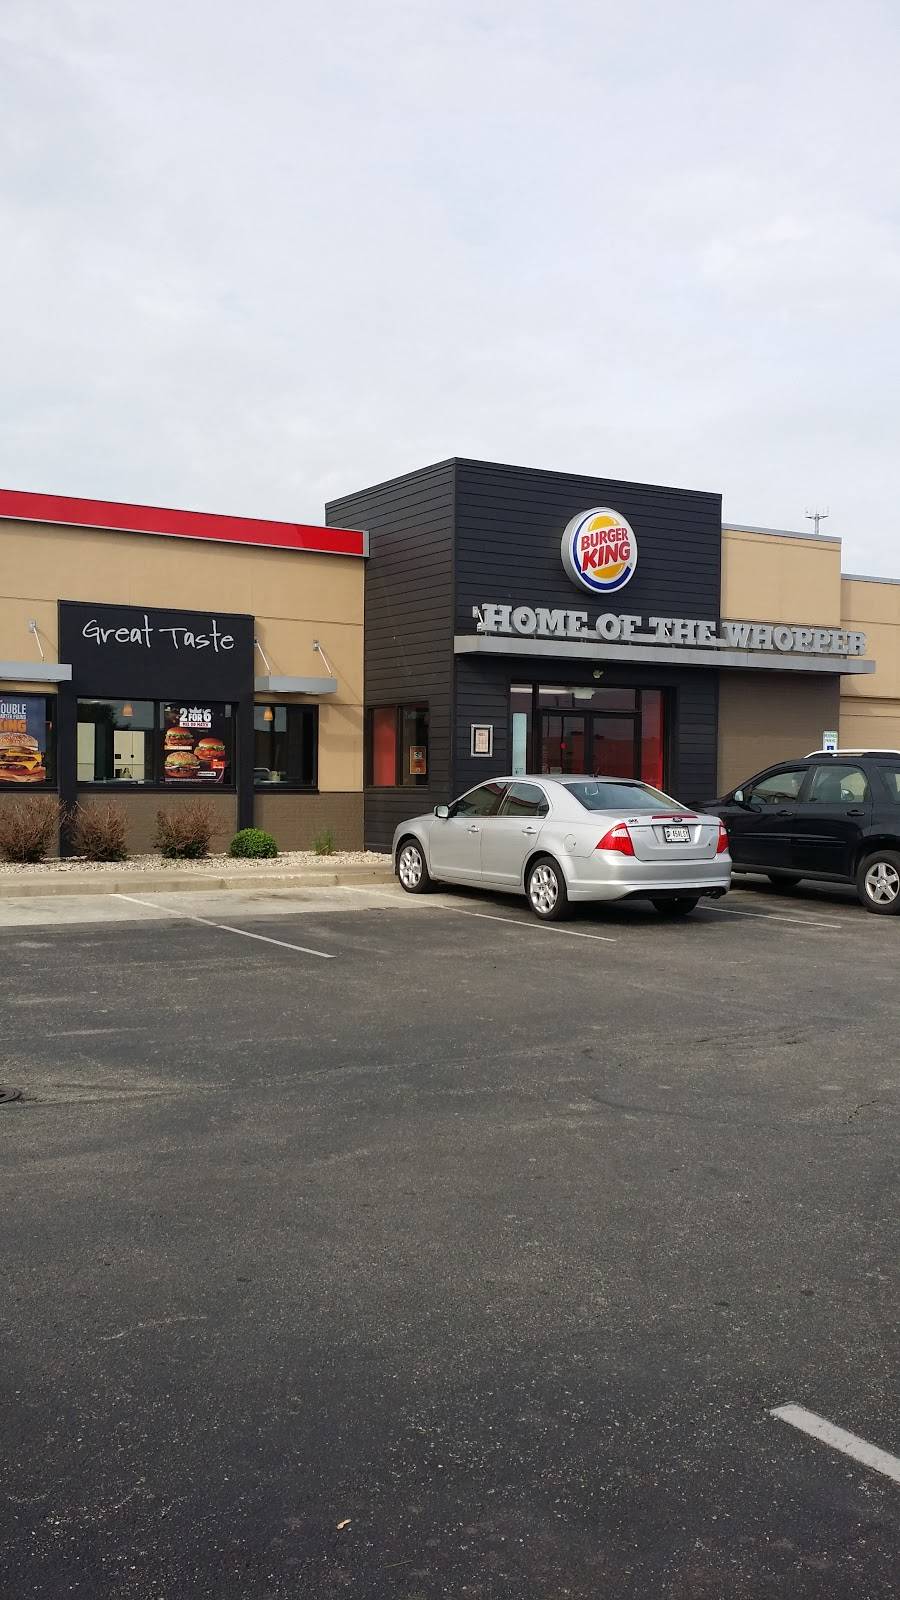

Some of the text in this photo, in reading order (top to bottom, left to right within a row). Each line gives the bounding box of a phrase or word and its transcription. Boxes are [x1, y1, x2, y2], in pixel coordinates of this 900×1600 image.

[580, 528, 629, 551] BURGER
[581, 541, 631, 574] KING
[82, 615, 235, 653] Great Taste
[481, 603, 867, 656] HOME OF THE WHOPPER
[179, 708, 188, 722] 2
[188, 713, 203, 722] FOR
